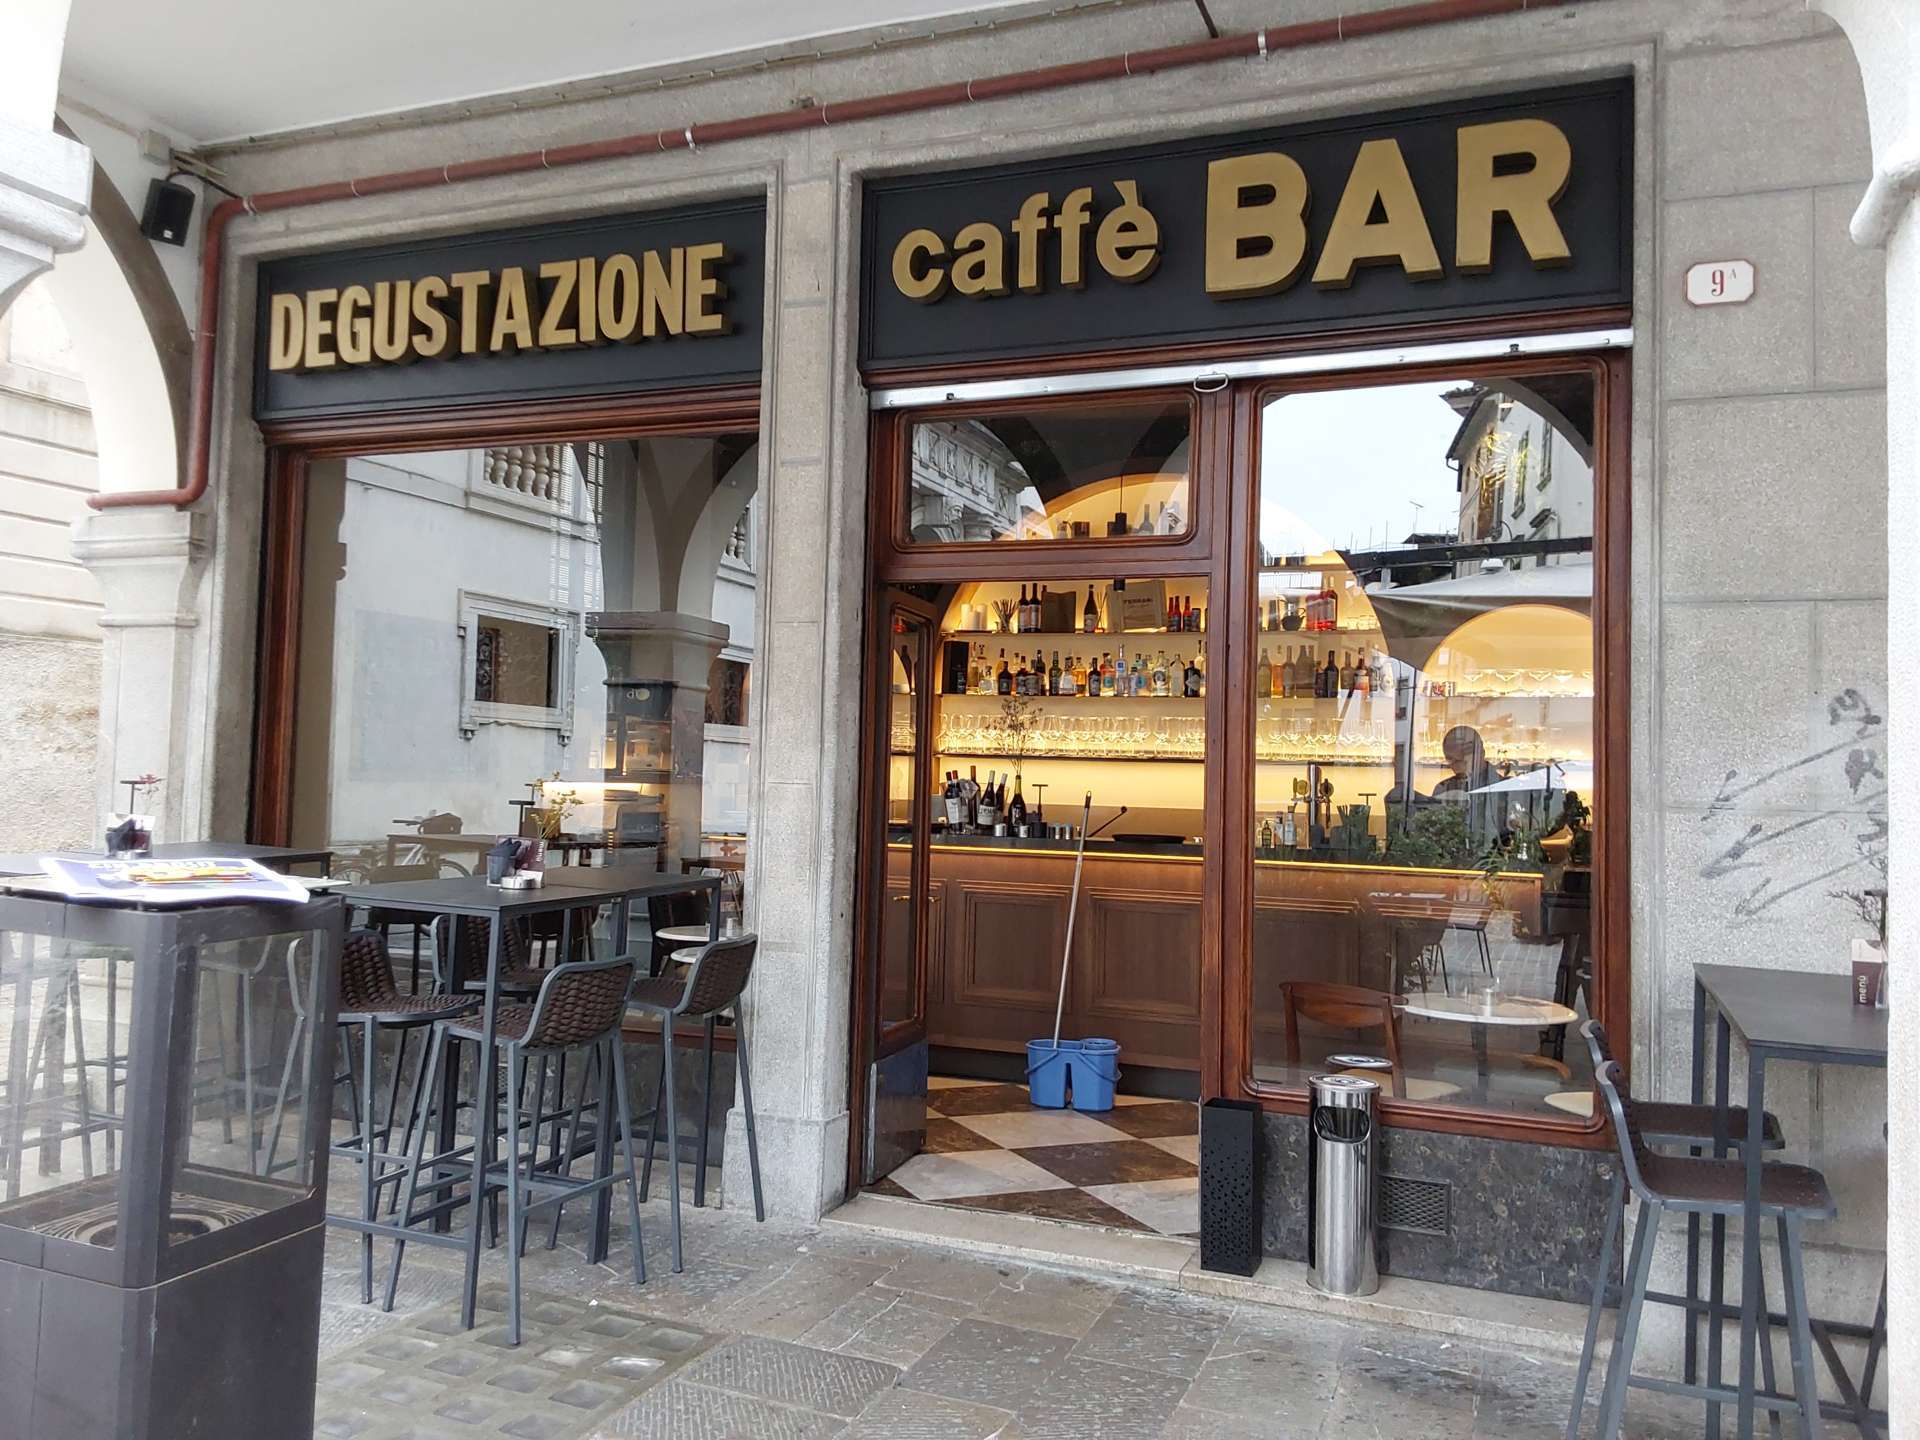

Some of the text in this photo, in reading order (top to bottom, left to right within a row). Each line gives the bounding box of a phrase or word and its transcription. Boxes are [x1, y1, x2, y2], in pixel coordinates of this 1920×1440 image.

[891, 118, 1573, 300] caffè BAR
[269, 243, 726, 371] DEGUSTAZIONE
